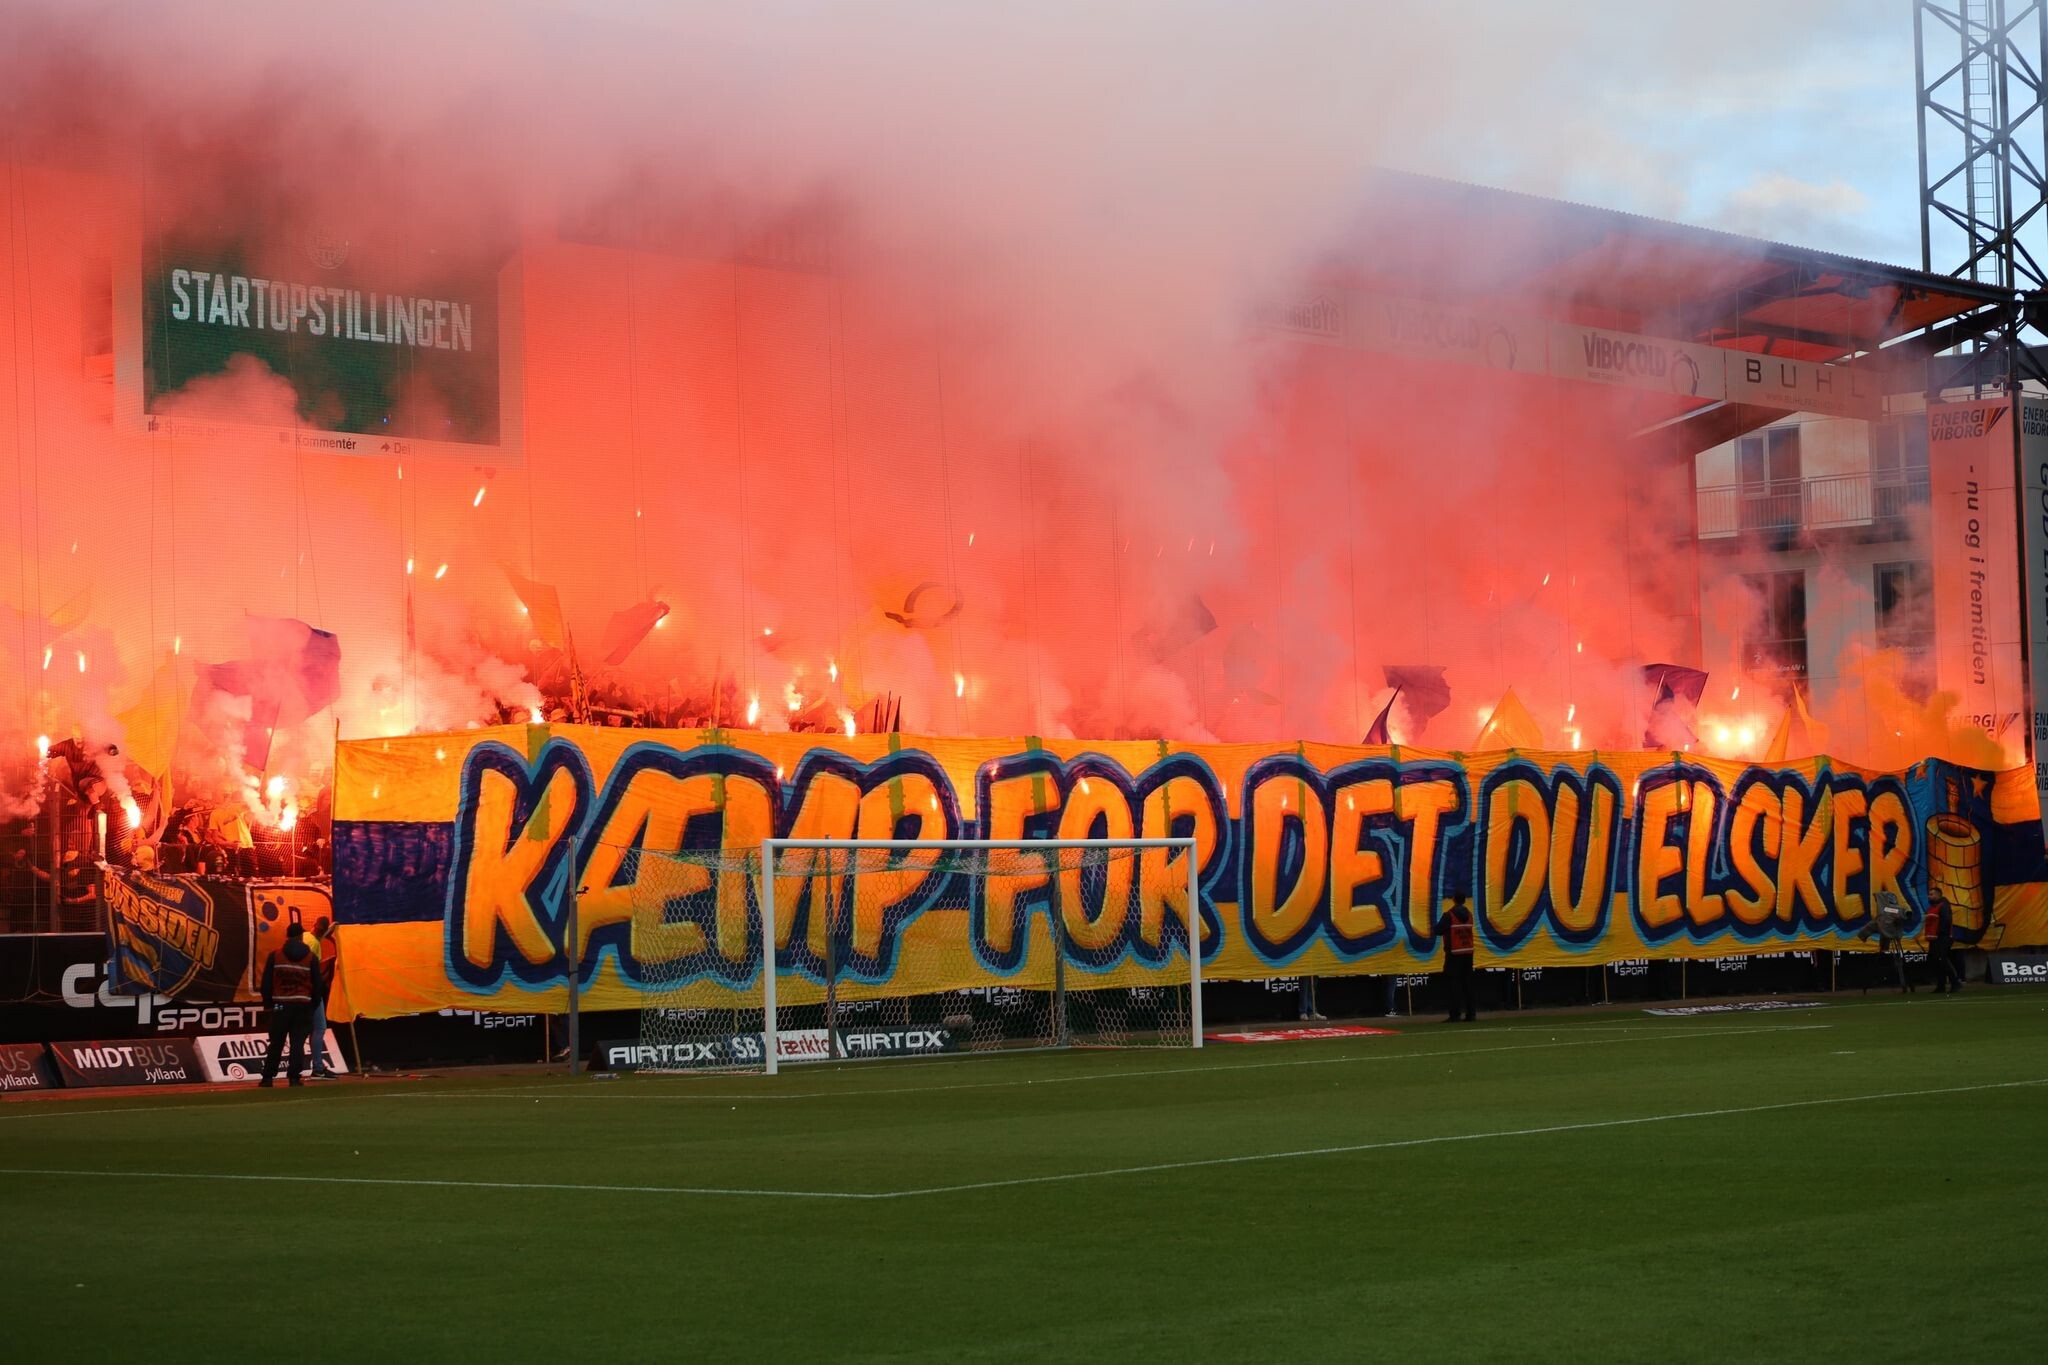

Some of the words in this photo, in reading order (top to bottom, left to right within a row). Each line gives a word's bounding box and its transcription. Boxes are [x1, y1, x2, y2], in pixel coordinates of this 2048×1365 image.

[172, 268, 472, 352] STARTOPSTILLINGEN
[1583, 332, 1667, 377] VIBOCOLD
[1746, 358, 1866, 399] BUHL
[1932, 409, 1985, 427] ENERGI
[1931, 424, 1983, 441] VIBORG
[1967, 481, 1979, 510] nu
[1965, 519, 1980, 548] og
[1970, 570, 1988, 685] fremtiden
[453, 745, 957, 983] KÆMP
[975, 752, 1226, 970] FOR
[1244, 757, 1467, 960] DET
[1482, 764, 1620, 949] DU
[1635, 764, 1917, 942] ELSKER
[1720, 960, 1748, 972] SPORT
[1904, 953, 1928, 964] SPORT
[1619, 966, 1648, 976] SPORT
[2002, 961, 2048, 977] Bac
[1396, 976, 1429, 987] SPORT
[2004, 976, 2047, 984] GRUPPEN
[837, 1000, 881, 1013] SPORT
[158, 1007, 264, 1031] SPORT
[484, 1015, 536, 1029] SPORT
[732, 1036, 760, 1058] SB
[846, 1031, 944, 1051] AIRTOX
[74, 1044, 180, 1069] MIDTBUS
[608, 1042, 716, 1066] AIRTOX
[0, 1073, 40, 1090] ylland
[144, 1067, 187, 1084] Jylland
